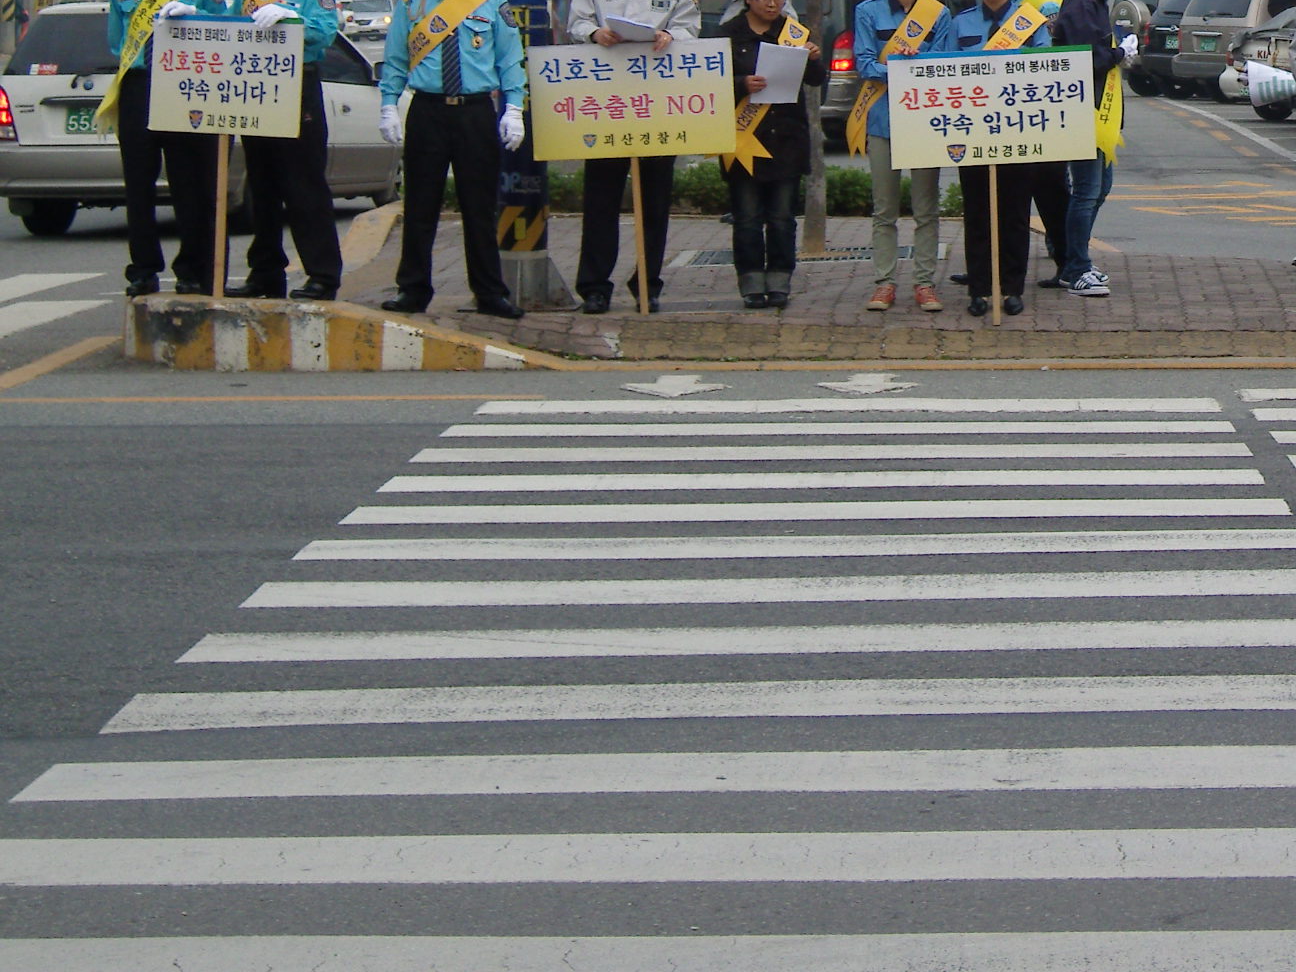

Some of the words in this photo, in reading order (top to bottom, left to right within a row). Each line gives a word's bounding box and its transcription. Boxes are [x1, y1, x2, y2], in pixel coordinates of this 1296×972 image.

[236, 28, 253, 43] 참여
[158, 48, 225, 76] 신호등은
[228, 51, 297, 78] 상호간의
[538, 57, 615, 85] 신호는
[625, 50, 727, 81] 직진부터
[1004, 60, 1027, 75] 참여
[1028, 57, 1072, 74] 봉사활동
[178, 77, 211, 103] 약속
[216, 79, 267, 106] 입니다
[898, 86, 990, 112] 신호등은
[996, 79, 1086, 107] 상호간의
[205, 113, 260, 130] 괴산경찰서
[552, 92, 655, 124] 예측출발
[666, 92, 717, 117] NO!
[929, 112, 975, 139] 약속
[982, 108, 1051, 137] 입니다
[602, 130, 688, 147] 괴산경찰서
[972, 143, 1044, 160] 괴산경찰서
